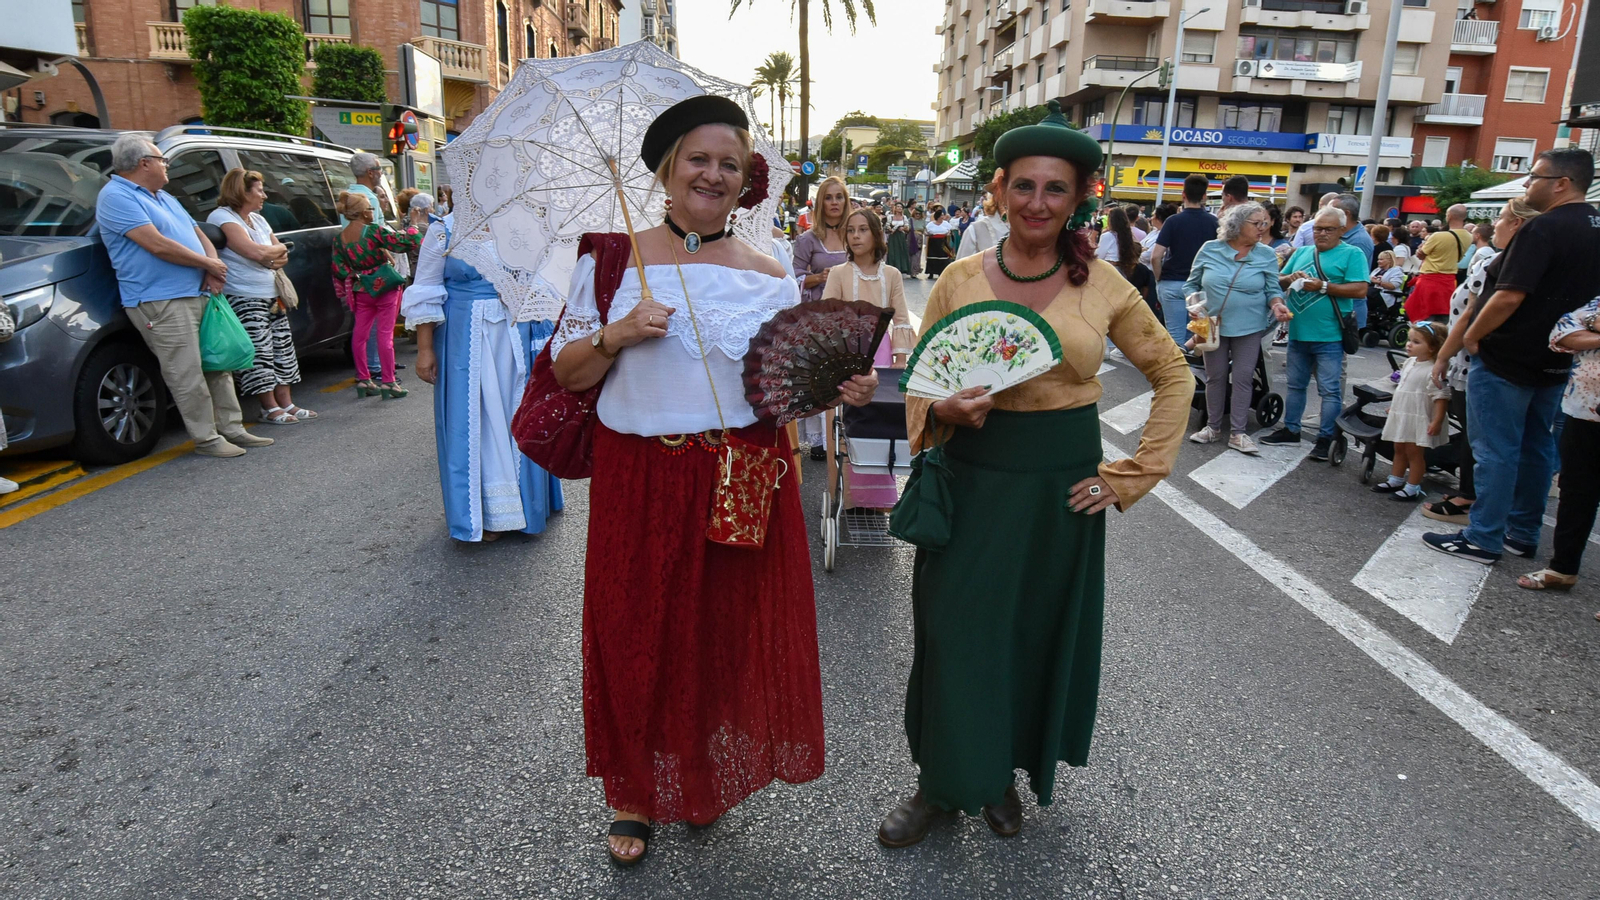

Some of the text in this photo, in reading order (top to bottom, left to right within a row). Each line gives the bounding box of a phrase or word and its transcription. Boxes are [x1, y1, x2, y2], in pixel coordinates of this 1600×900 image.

[356, 114, 382, 124] ONC
[1171, 129, 1268, 146] OCASO SEGUROS
[1198, 161, 1228, 172] Kodak
